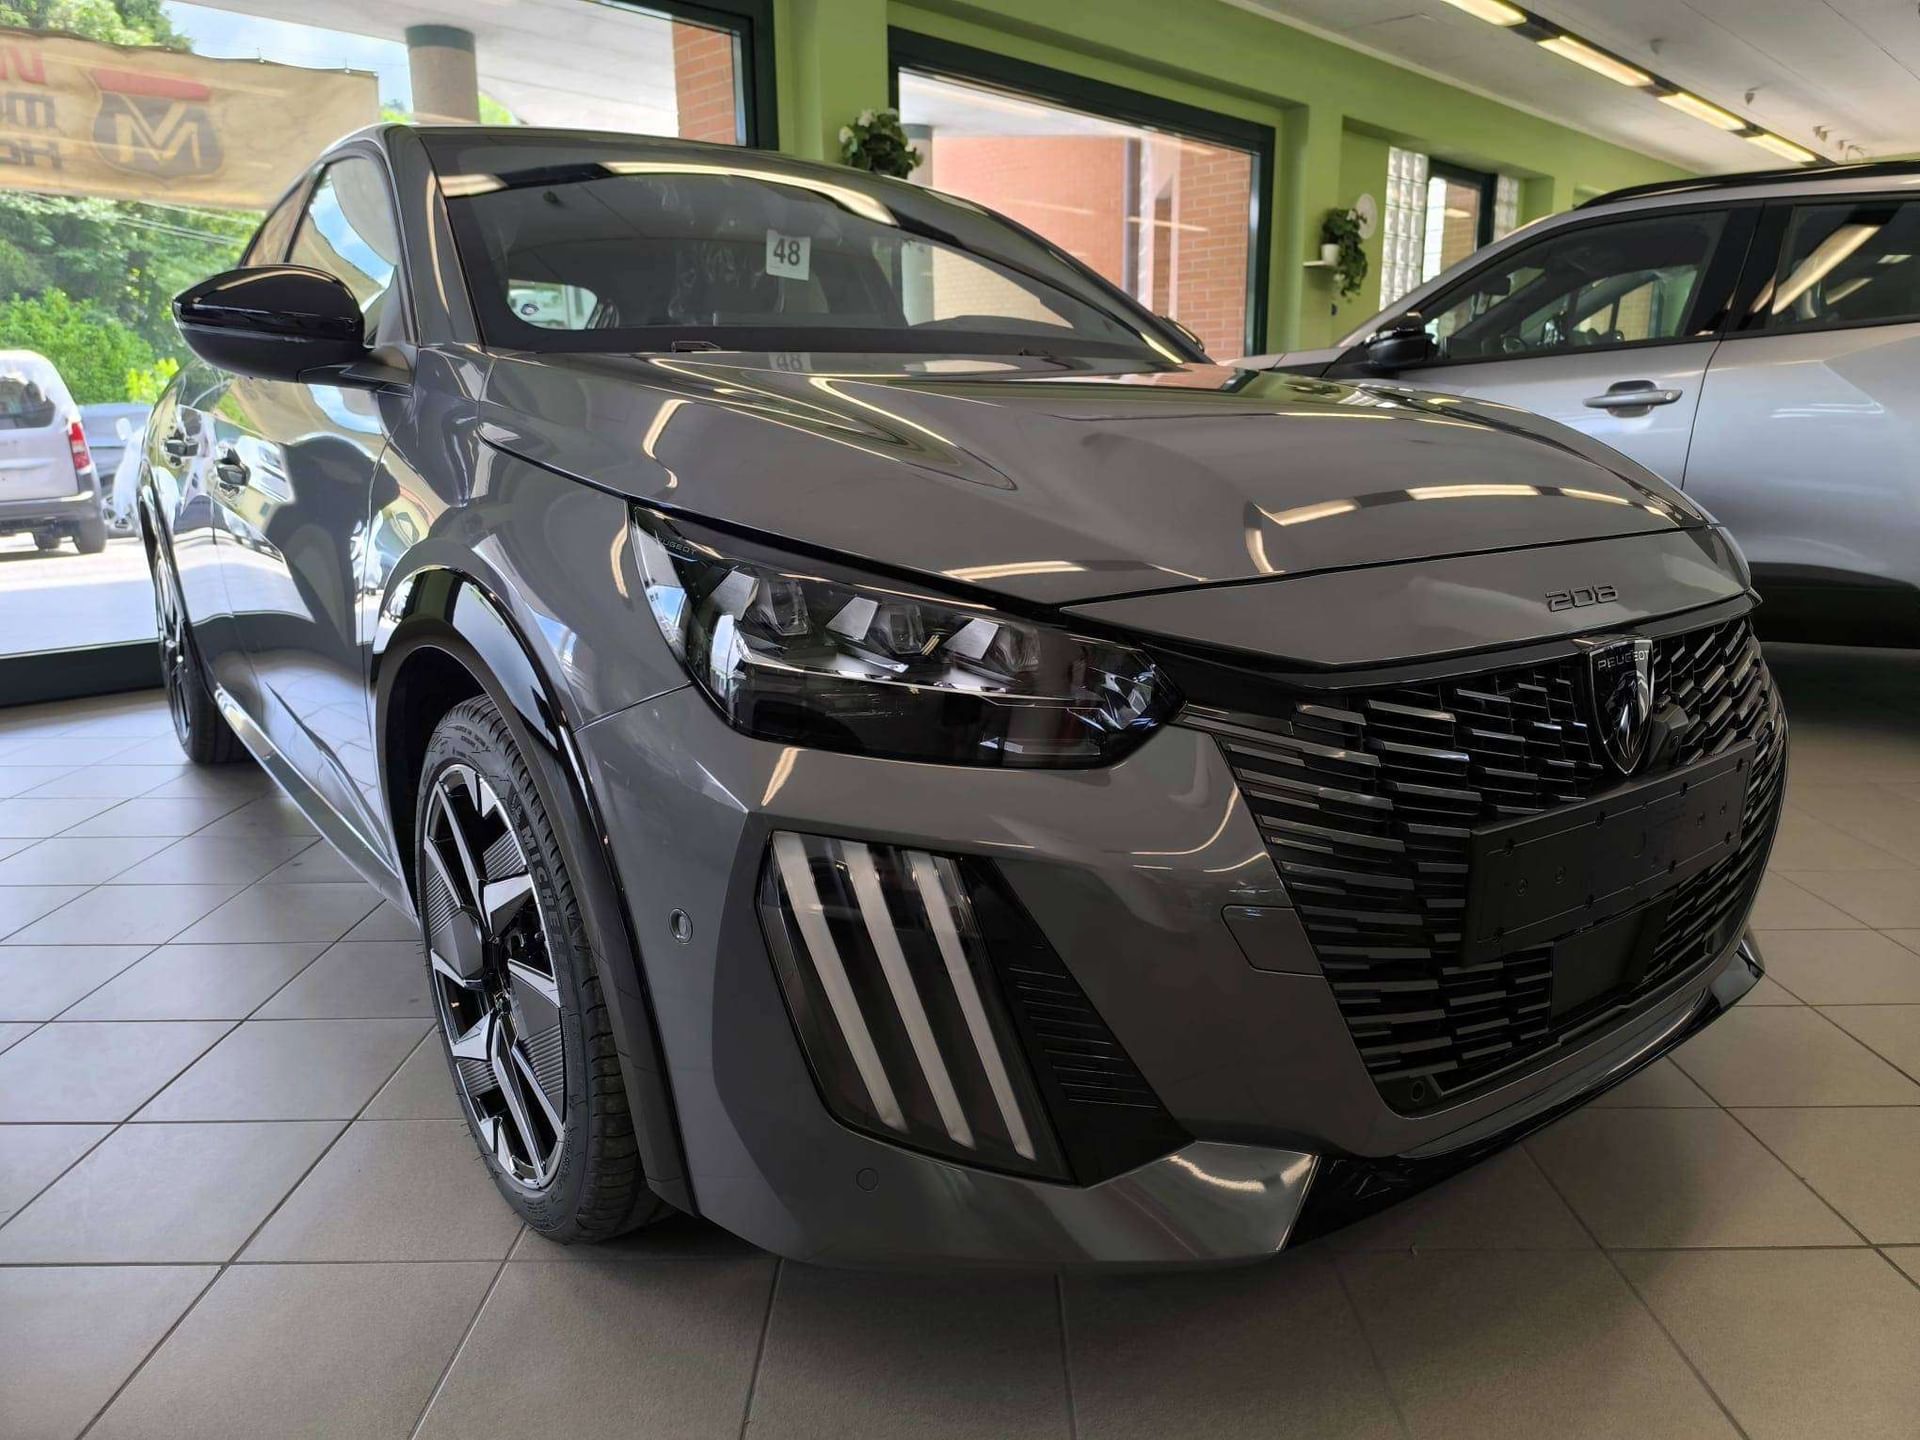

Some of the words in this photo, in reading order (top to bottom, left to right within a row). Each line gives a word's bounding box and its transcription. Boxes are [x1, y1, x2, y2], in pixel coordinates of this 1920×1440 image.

[773, 237, 801, 266] 48
[1544, 584, 1618, 613] 208
[1597, 650, 1650, 670] PEUGEOT
[521, 825, 572, 977] MICHEL
